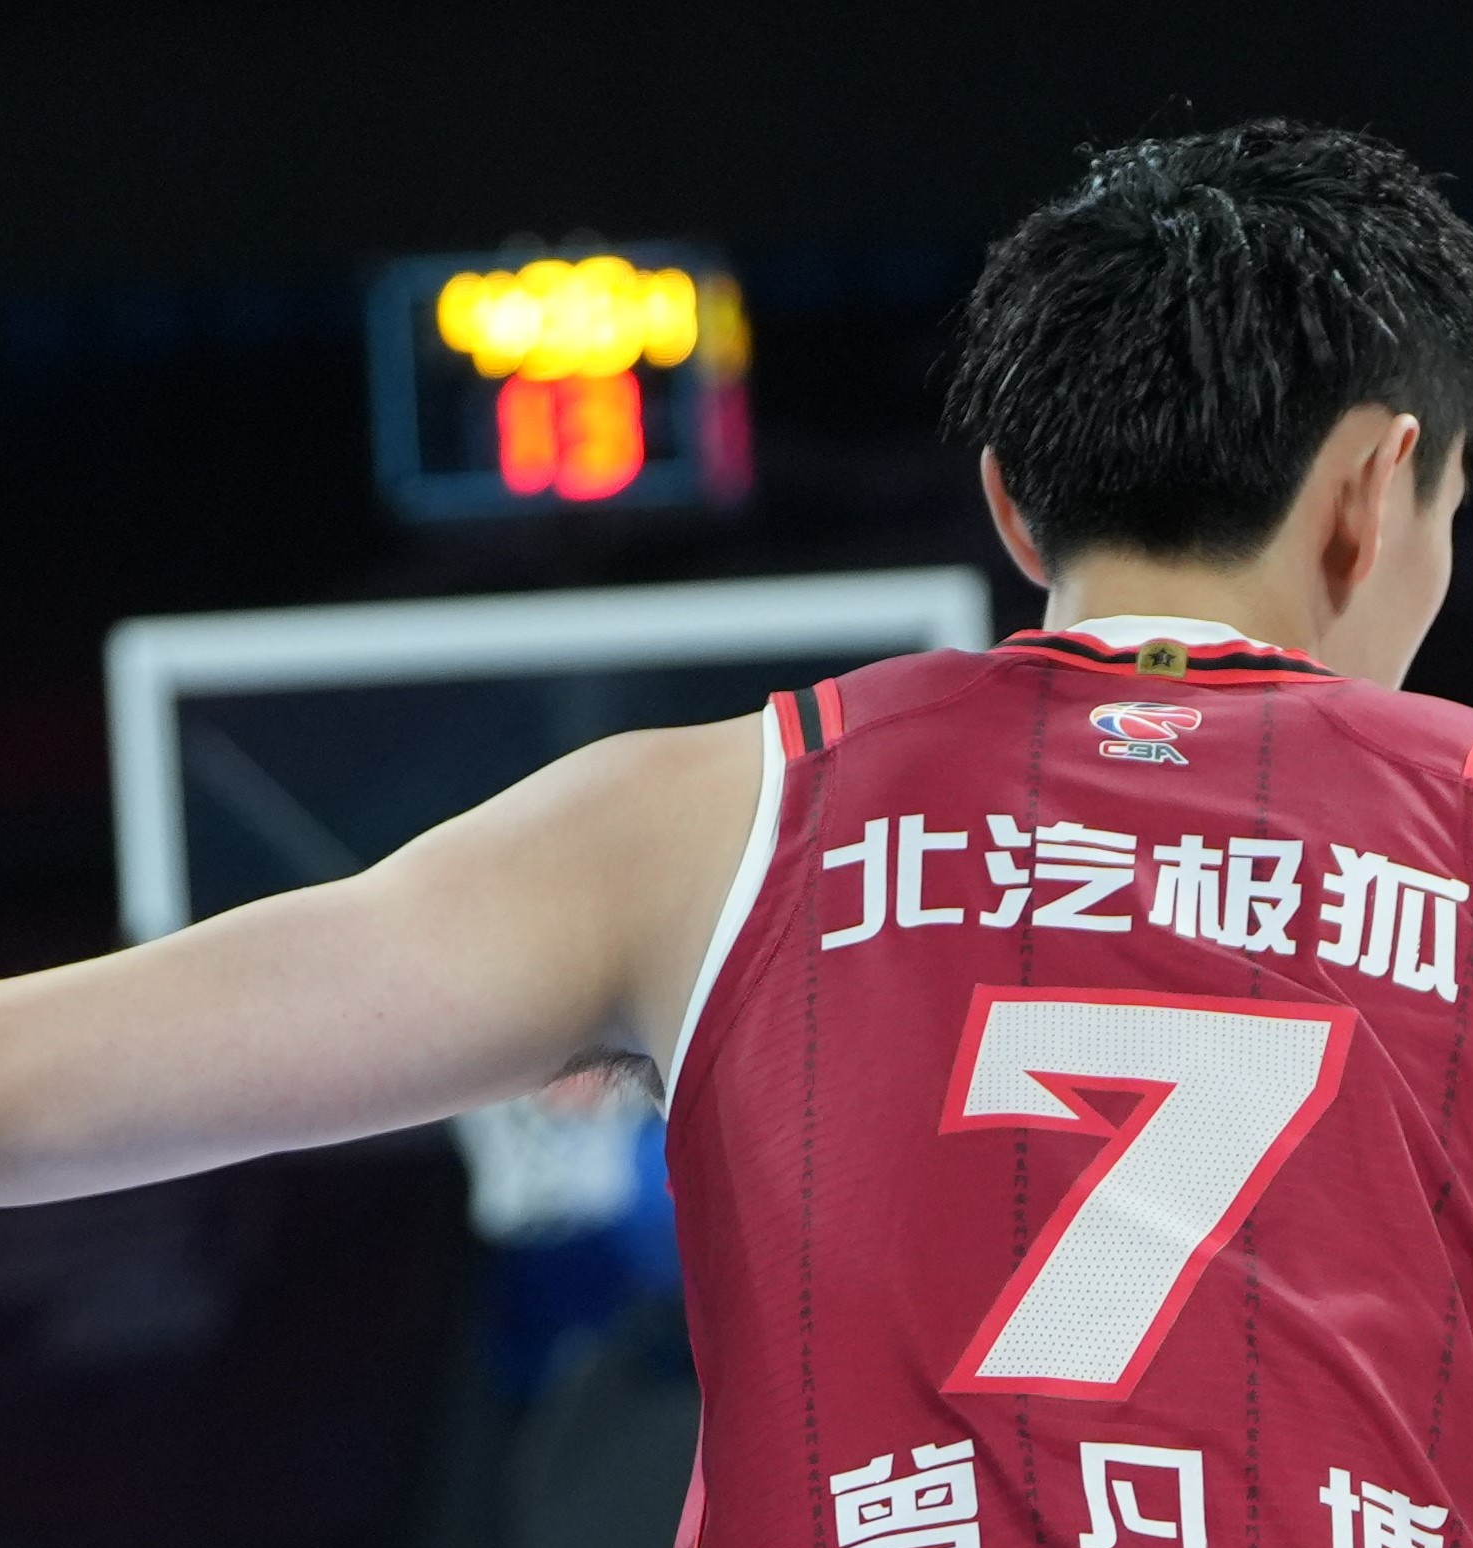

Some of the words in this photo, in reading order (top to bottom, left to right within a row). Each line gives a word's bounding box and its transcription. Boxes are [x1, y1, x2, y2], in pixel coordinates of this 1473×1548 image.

[1098, 740, 1190, 766] CBA
[820, 813, 1471, 1003] 北汽极狐
[952, 992, 1345, 1392] 7
